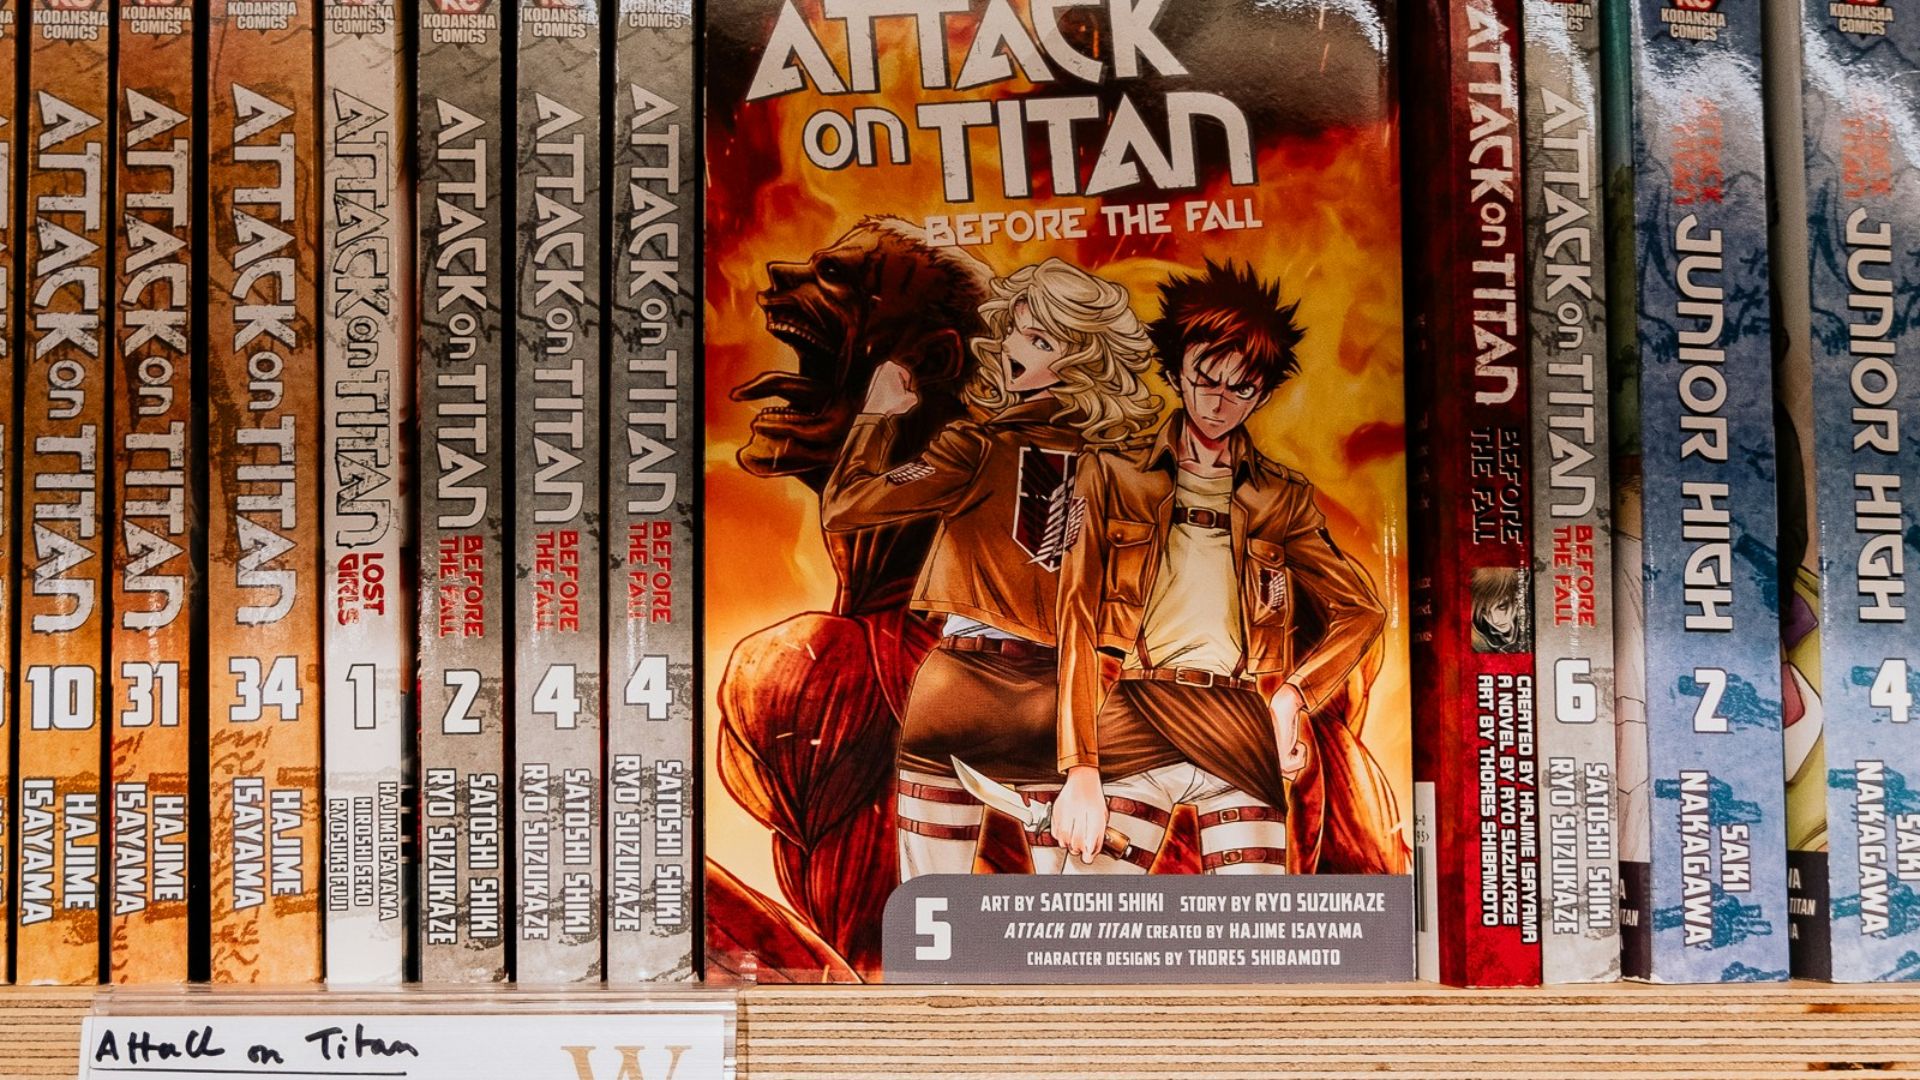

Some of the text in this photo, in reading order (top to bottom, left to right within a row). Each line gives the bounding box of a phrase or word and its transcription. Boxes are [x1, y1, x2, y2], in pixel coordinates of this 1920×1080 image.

[34, 10, 108, 25] KODANSHA
[43, 25, 97, 40] COMICS
[122, 7, 191, 21] KODANSHA
[131, 20, 182, 34] COMICS
[228, 2, 296, 15] KODANSHA
[237, 15, 288, 30] COMICS
[325, 6, 393, 20] KODANSHA
[333, 19, 384, 33] COMICS
[423, 14, 496, 28] KODANSHA
[432, 28, 486, 43] COMICS
[533, 22, 587, 38] COMICS
[629, 13, 682, 28] COMICS
[746, 0, 1188, 100] ATTACK
[1661, 8, 1726, 28] KODANSHA
[1670, 24, 1718, 41] COMICS
[1829, 4, 1893, 22] KODANSHA
[1838, 18, 1885, 35] COMICS
[916, 92, 1254, 203] TITAN
[1466, 5, 1514, 203] ATTACK
[34, 90, 101, 358] ATTACK
[123, 87, 189, 355] ATTACK
[231, 82, 295, 352] ATTACK
[333, 88, 390, 318] ATTACK
[436, 98, 487, 311] ATTACK
[534, 92, 585, 306] ATTACK
[629, 83, 680, 297] ATTACK
[924, 198, 1262, 247] BEFORE THE FALL
[1542, 87, 1592, 299] ATTACK
[1472, 253, 1519, 406] TITAN
[335, 370, 391, 549] TITAN
[437, 364, 488, 528] TITAN
[533, 359, 584, 523] TITAN
[627, 350, 678, 515] TITAN
[1548, 354, 1596, 518] TITAN
[1675, 214, 1733, 631] JUNIOR HIGH
[1846, 207, 1908, 622] JUNIOR HIGH
[33, 424, 96, 635] TITAN
[123, 421, 186, 630] TITAN
[235, 415, 297, 626] TITAN
[1471, 427, 1495, 545] THE FALL
[1499, 427, 1523, 545] BEFORE
[337, 553, 360, 626] GIRLS
[363, 552, 384, 616] LOST
[439, 536, 459, 581] THE
[463, 534, 483, 638] BEFORE
[535, 531, 555, 575] THE
[559, 529, 579, 633] BEFORE
[629, 522, 648, 565] THE
[652, 520, 672, 624] BEFORE
[1552, 525, 1573, 628] THE FALL
[1575, 525, 1596, 629] BEFORE
[25, 664, 96, 731] 10
[120, 661, 180, 727] 31
[229, 656, 303, 722] 34
[346, 663, 376, 729] 1
[442, 668, 482, 734] 2
[532, 664, 581, 729] 4
[624, 654, 672, 721] 4
[1554, 658, 1598, 723] 6
[1693, 667, 1728, 733] 2
[1870, 658, 1912, 722] 4
[64, 793, 97, 910] HAJIME
[114, 782, 147, 915] ISAYAMA
[152, 794, 187, 902] HAJIME
[232, 777, 265, 910] ISAYAMA
[270, 789, 303, 896] HAJIME
[353, 797, 373, 906] HIROSHI SEKO
[378, 781, 399, 921] HAJIME ISAYAMA
[522, 763, 549, 940] RYO SUZUKAZE
[563, 768, 591, 935] SATOSHI SHIKI
[613, 754, 641, 932] RYO SUZUKAZE
[655, 760, 683, 927] SATOSHI SHIKI
[1478, 675, 1499, 927] ART BY THORES SHIBAMOTO
[1498, 674, 1518, 926] A NOVEL BY RYO SUZUKAZE
[1516, 675, 1538, 943] CREATED BY HAJIME ISAYAMA
[1549, 757, 1579, 934] RYO SUZUKAZE
[1584, 763, 1612, 929] SATOSHI SHIKI
[1855, 760, 1888, 935] NAKAGAWA
[1895, 813, 1920, 880] SAKI
[21, 778, 54, 927] ISAYAMA
[329, 799, 349, 911] RYOSUKE FUJI
[426, 768, 457, 945] RYO SUZUKAZE
[468, 774, 498, 939] SATOSHI SHIKI
[980, 893, 1164, 912] ART BY SATOSHI SHIKI
[1180, 893, 1385, 912] STORY BY RYO SUZUKAZE
[1679, 770, 1713, 946] NAKAGAWA
[1720, 824, 1751, 893] SAKI
[915, 897, 951, 960] 5
[1004, 922, 1363, 939] ATTACK ON TITAN CREATED BY HAJIME ISAYAMA
[1026, 948, 1341, 966] CHARACTER DESIGNS BY THORES SHIBAMOTO
[248, 1044, 285, 1065] on
[305, 1024, 420, 1060] Titan
